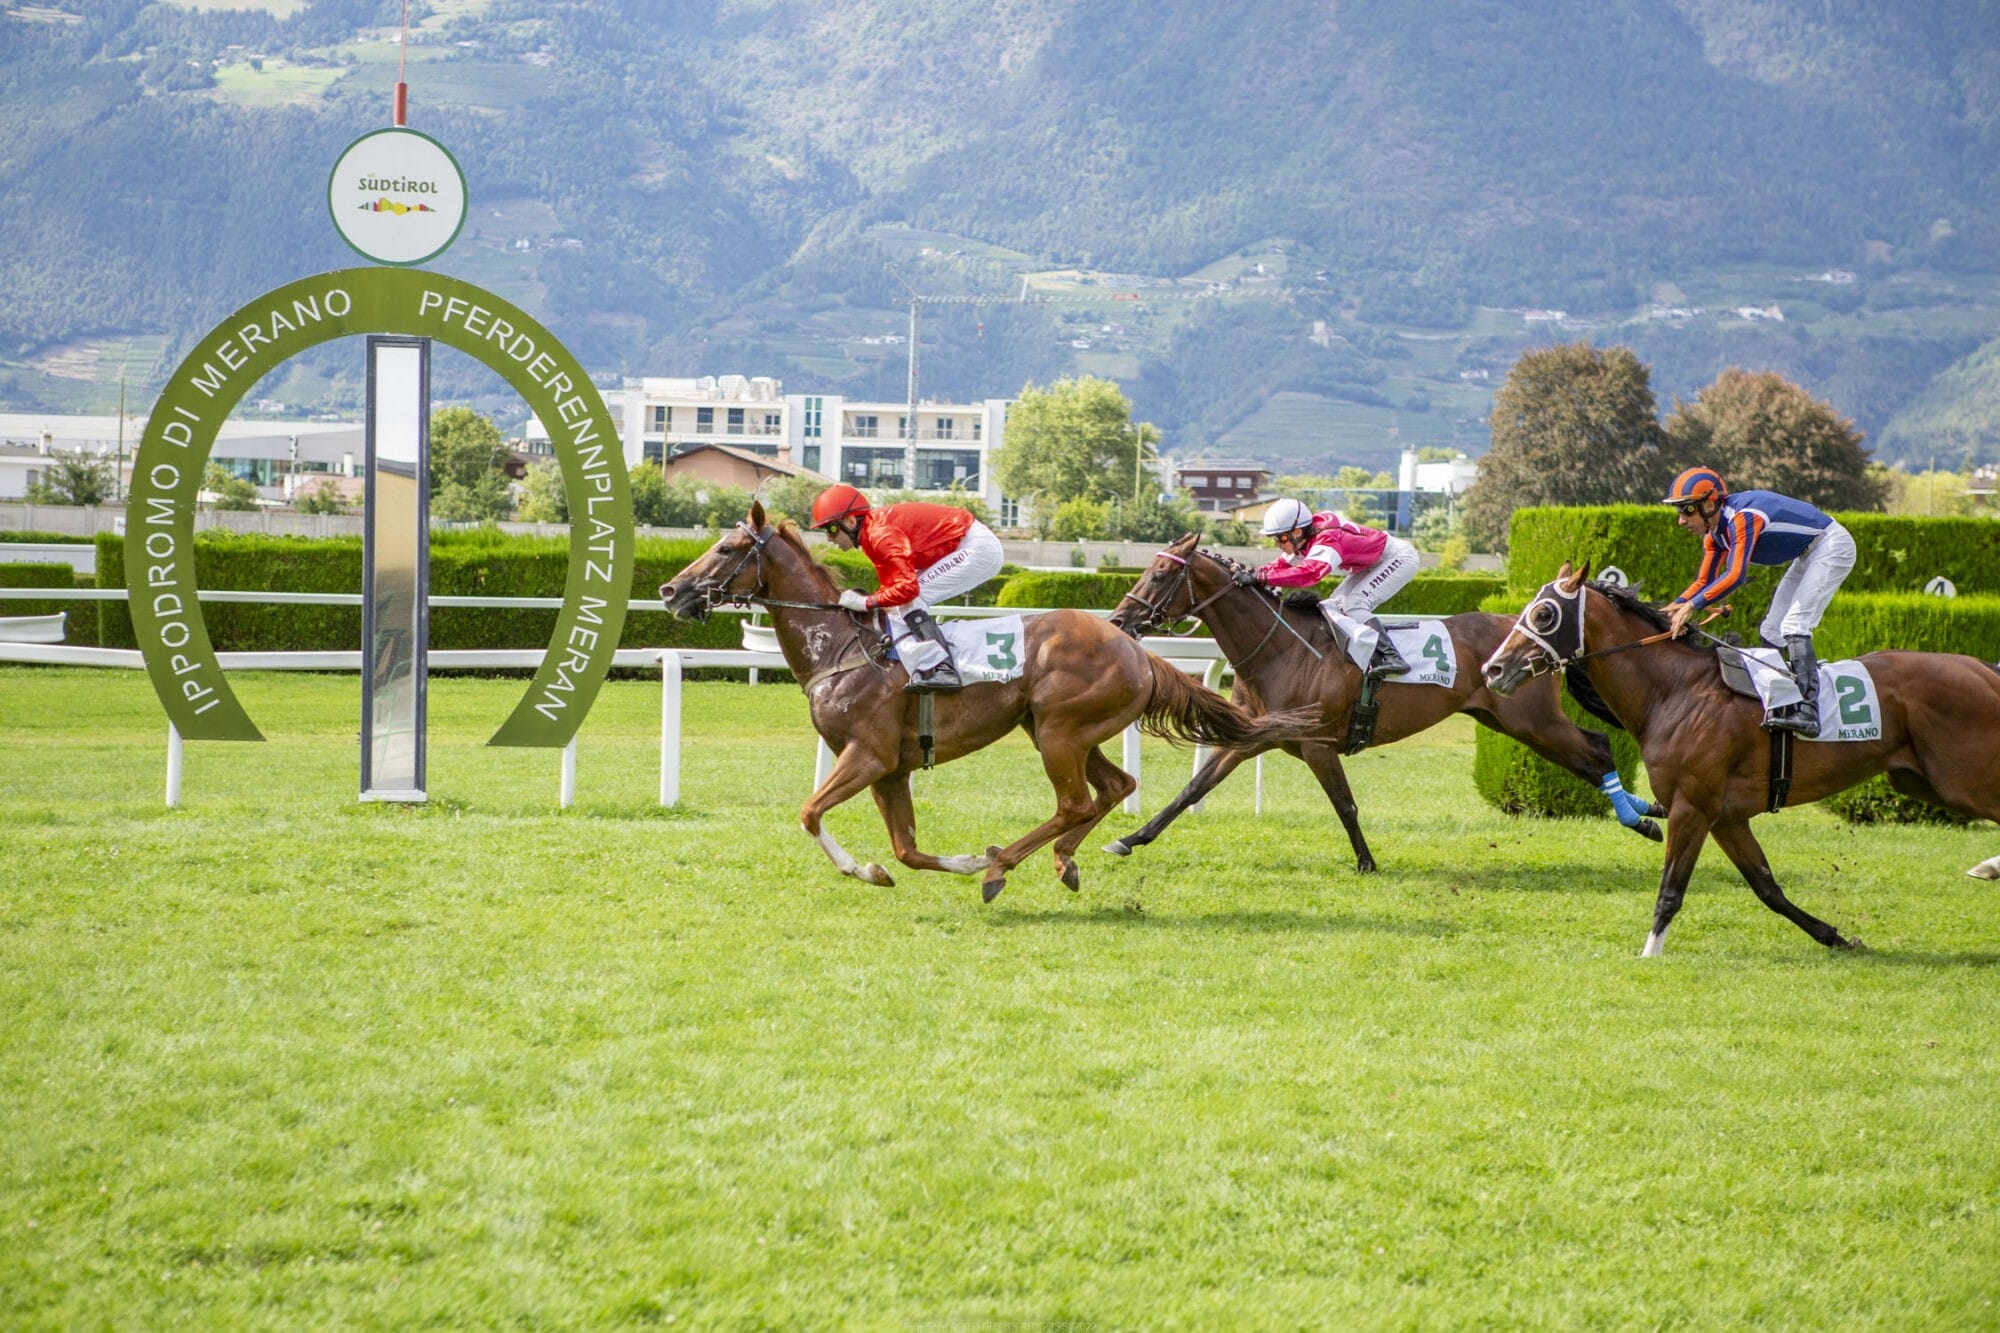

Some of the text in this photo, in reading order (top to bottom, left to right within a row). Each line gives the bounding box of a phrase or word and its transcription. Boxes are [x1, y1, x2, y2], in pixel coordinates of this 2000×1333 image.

[146, 288, 352, 715] IPPODROMO DI MERANO
[418, 290, 615, 721] PFERDERENNPLATZ MERAN
[1369, 558, 1403, 589] SPAMPATT
[986, 632, 1017, 670] 3
[1423, 634, 1450, 672] 4
[1835, 675, 1872, 724] 2
